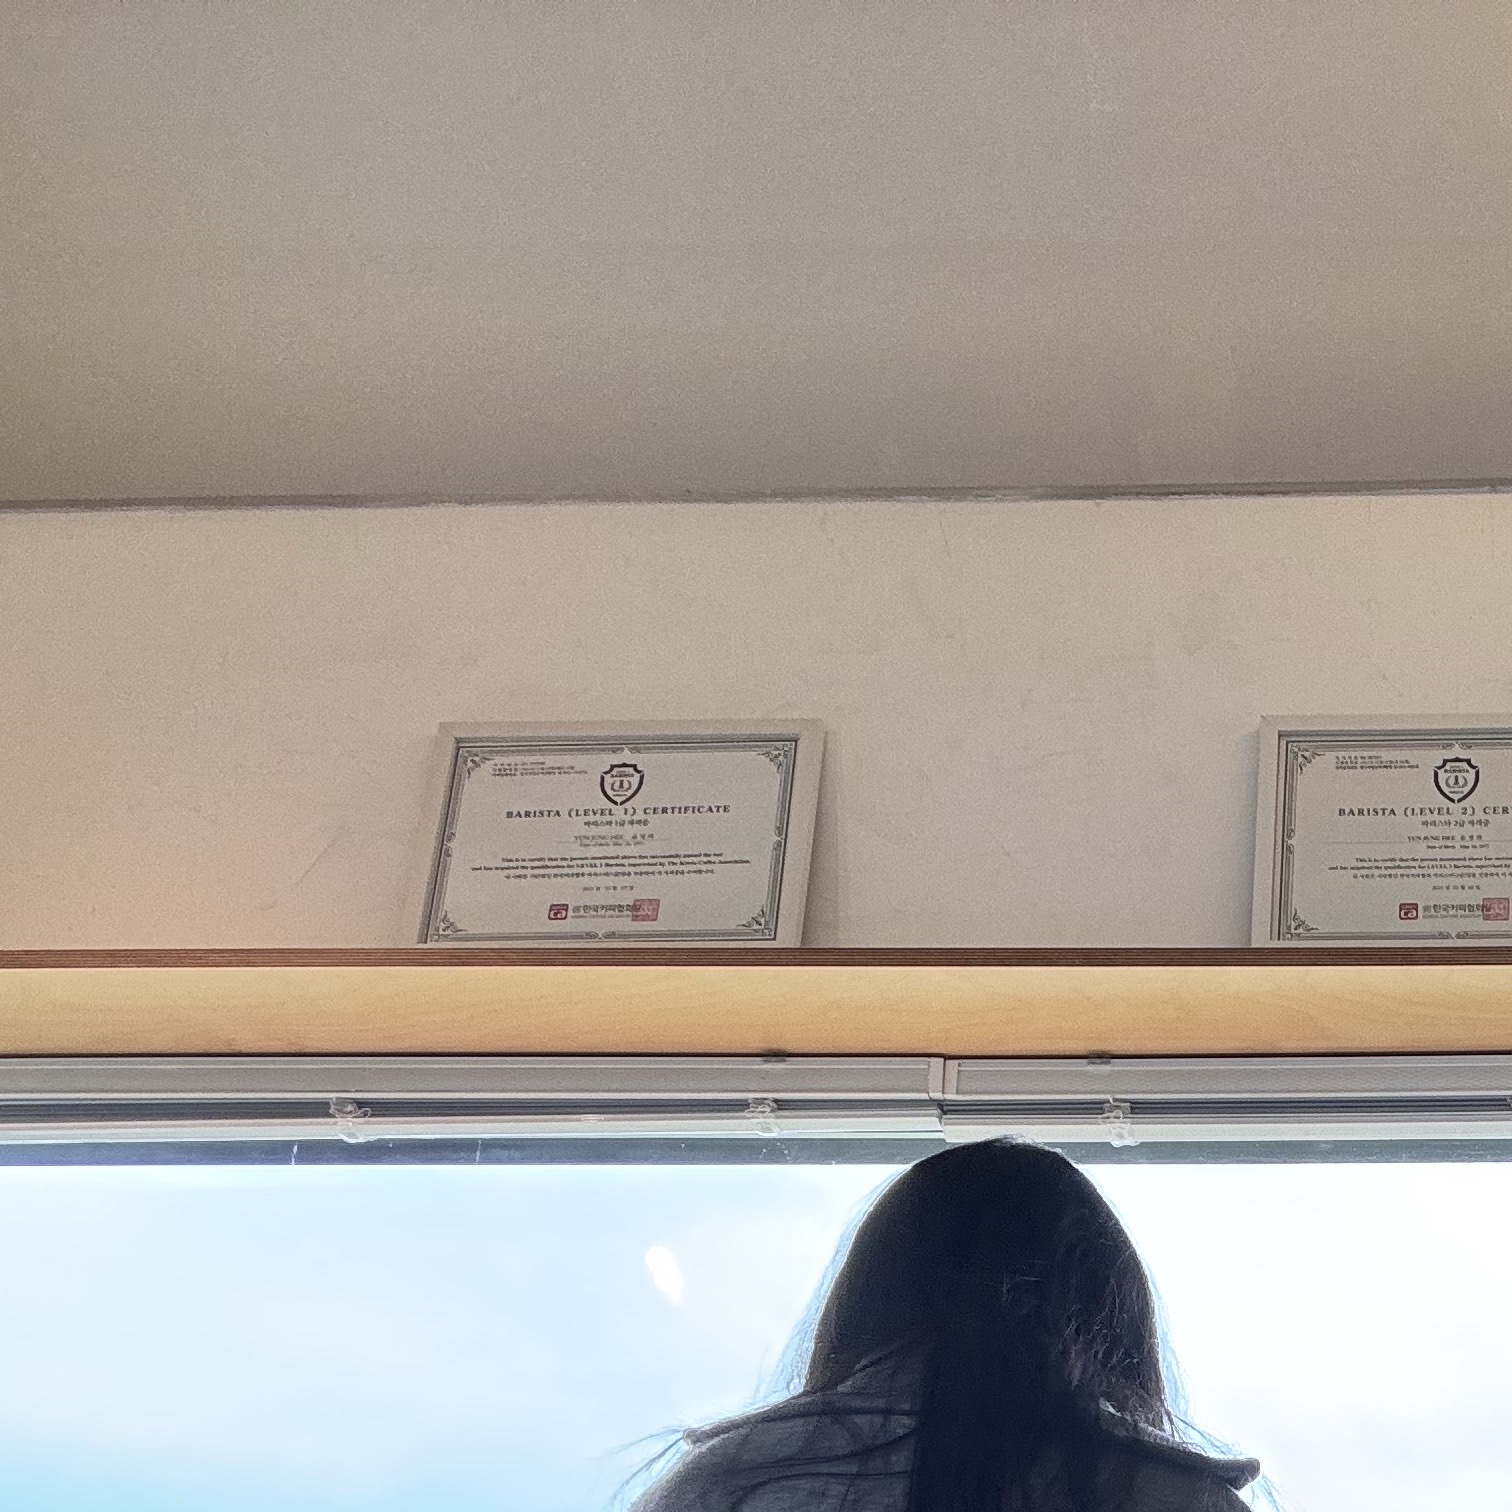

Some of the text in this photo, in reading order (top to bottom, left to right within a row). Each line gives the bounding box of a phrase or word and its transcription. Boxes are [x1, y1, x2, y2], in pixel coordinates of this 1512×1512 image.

[506, 809, 562, 819] BARISTA
[567, 807, 615, 818] (LEVEL
[643, 805, 731, 816] CERTIFICATE
[1338, 807, 1397, 817] BARISTA
[1403, 806, 1453, 818] (LEVEL
[1460, 805, 1476, 817] 2)
